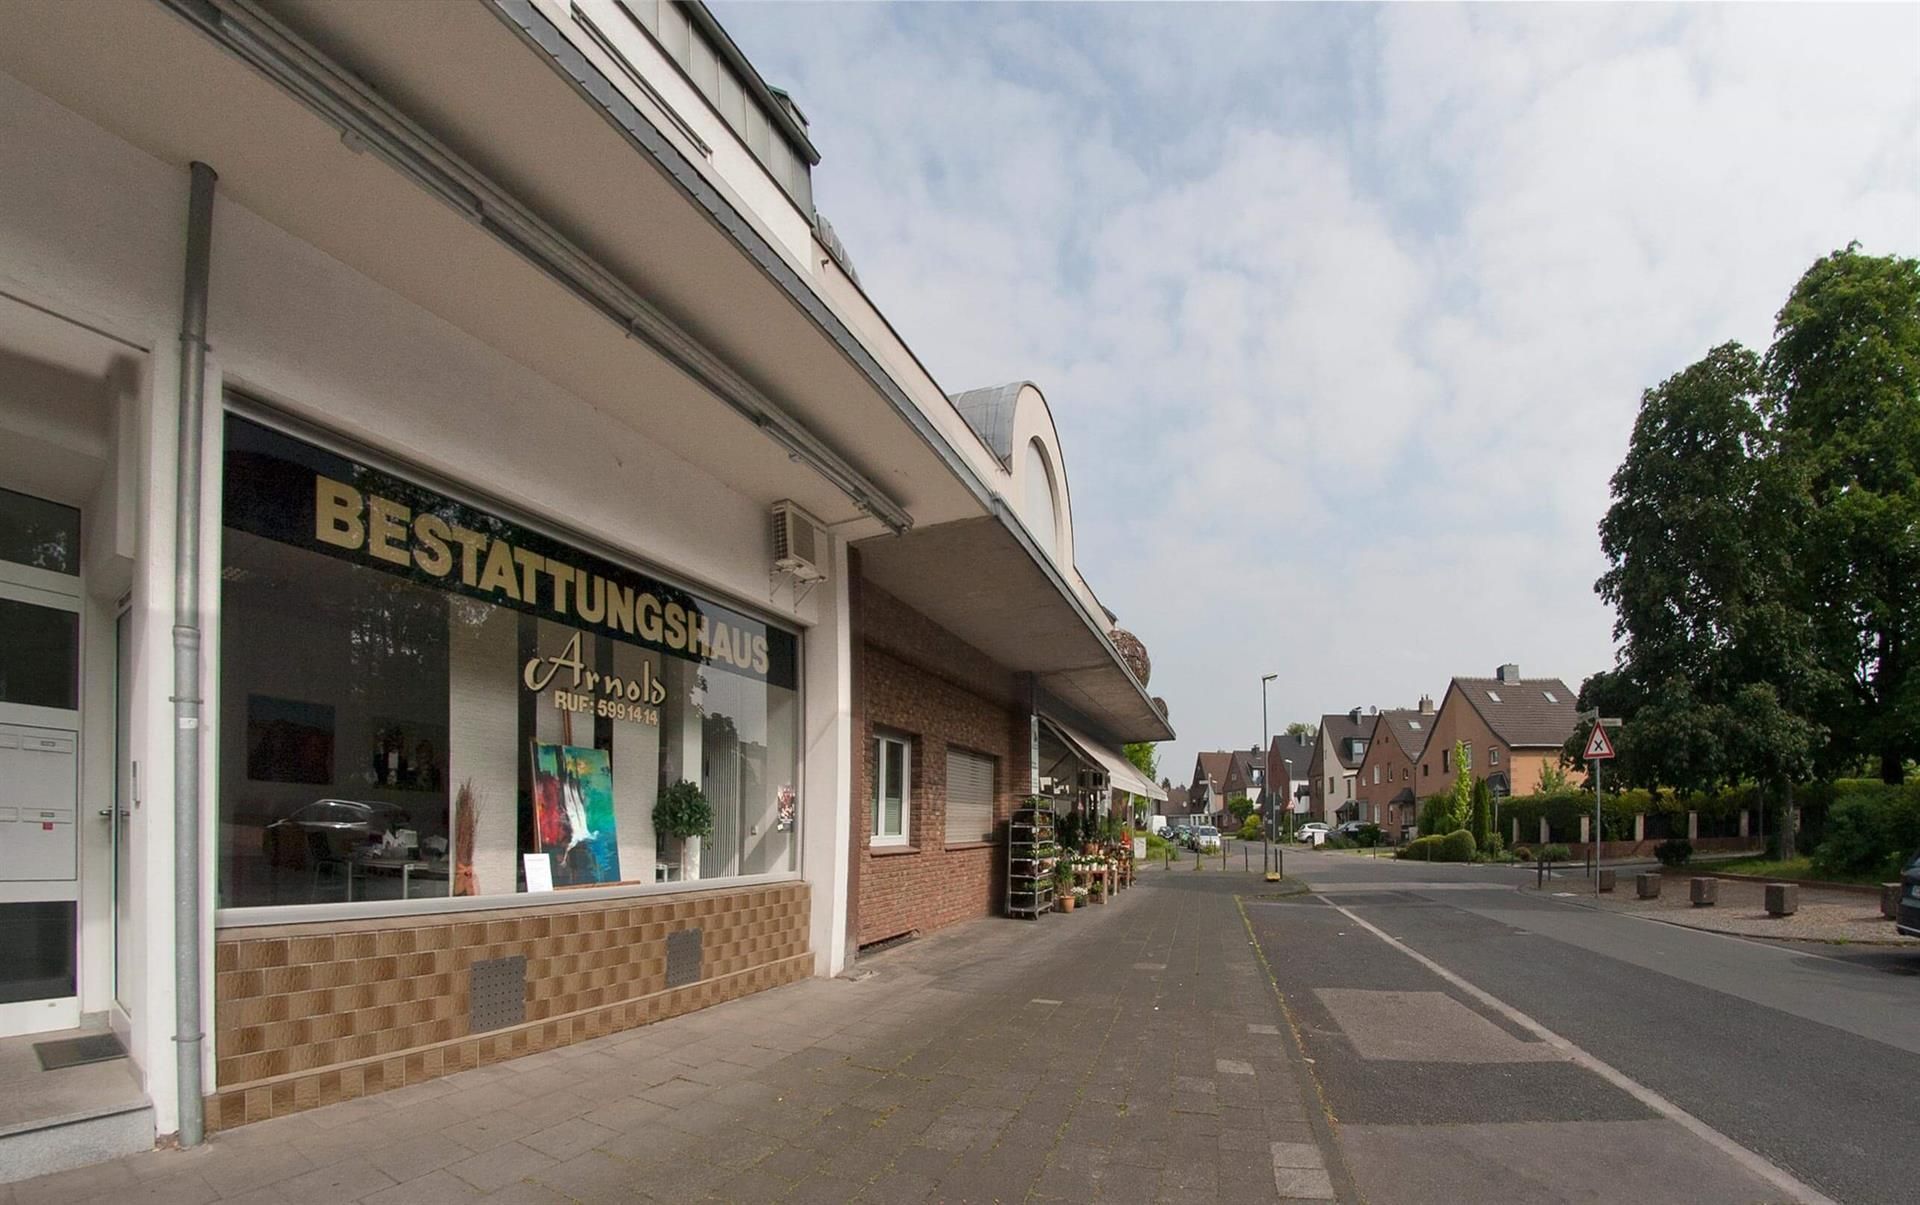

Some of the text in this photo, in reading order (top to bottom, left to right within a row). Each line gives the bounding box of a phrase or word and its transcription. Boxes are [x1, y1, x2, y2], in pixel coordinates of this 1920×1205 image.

[316, 474, 769, 674] BESTATTUNGSHAUS
[524, 631, 667, 704] Arnold
[554, 690, 594, 714] RUF:
